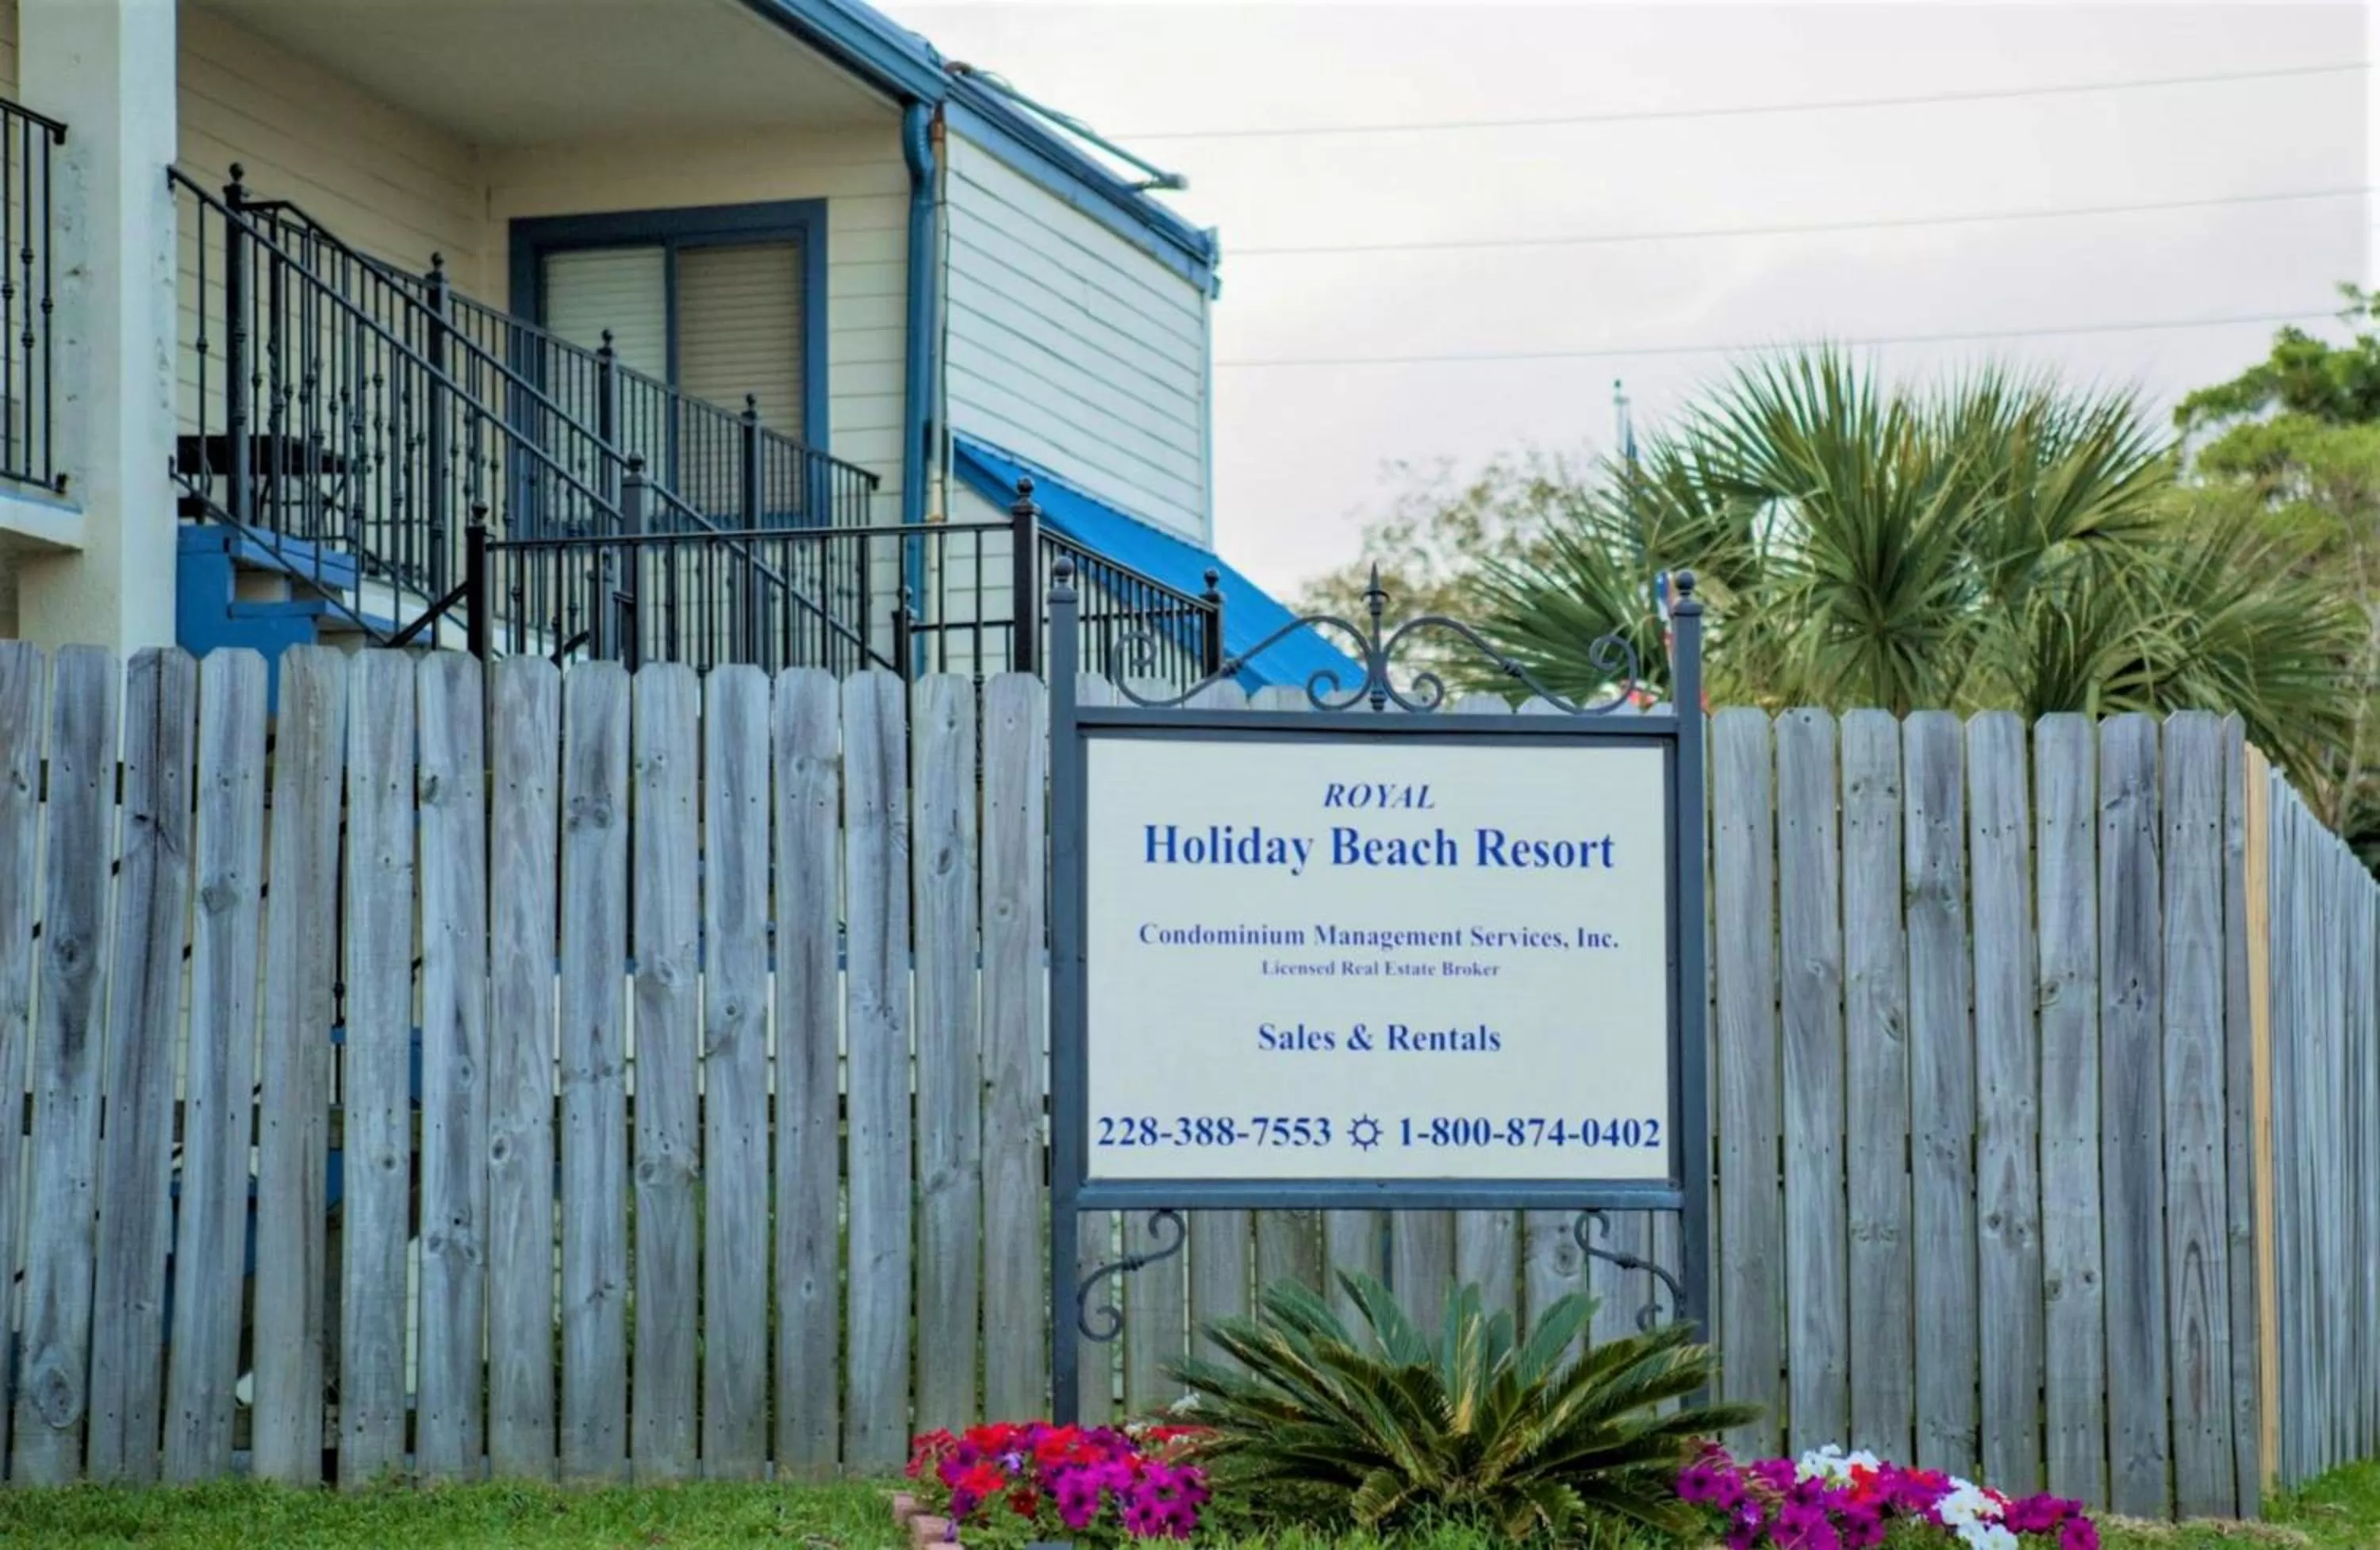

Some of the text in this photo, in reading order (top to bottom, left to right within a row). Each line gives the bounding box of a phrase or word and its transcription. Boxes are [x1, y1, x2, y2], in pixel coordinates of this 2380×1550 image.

[1324, 783, 1434, 809] ROYAL
[1145, 824, 1615, 876] Holiday Beach Resort
[1139, 923, 1619, 951] Condominium Management Services, Inc.
[1261, 959, 1501, 977] Licensed Real Estate Broker
[1257, 1022, 1502, 1053] Sales & Rentals
[1098, 1116, 1660, 1149] 228-388-7553 1-800-874-0402
